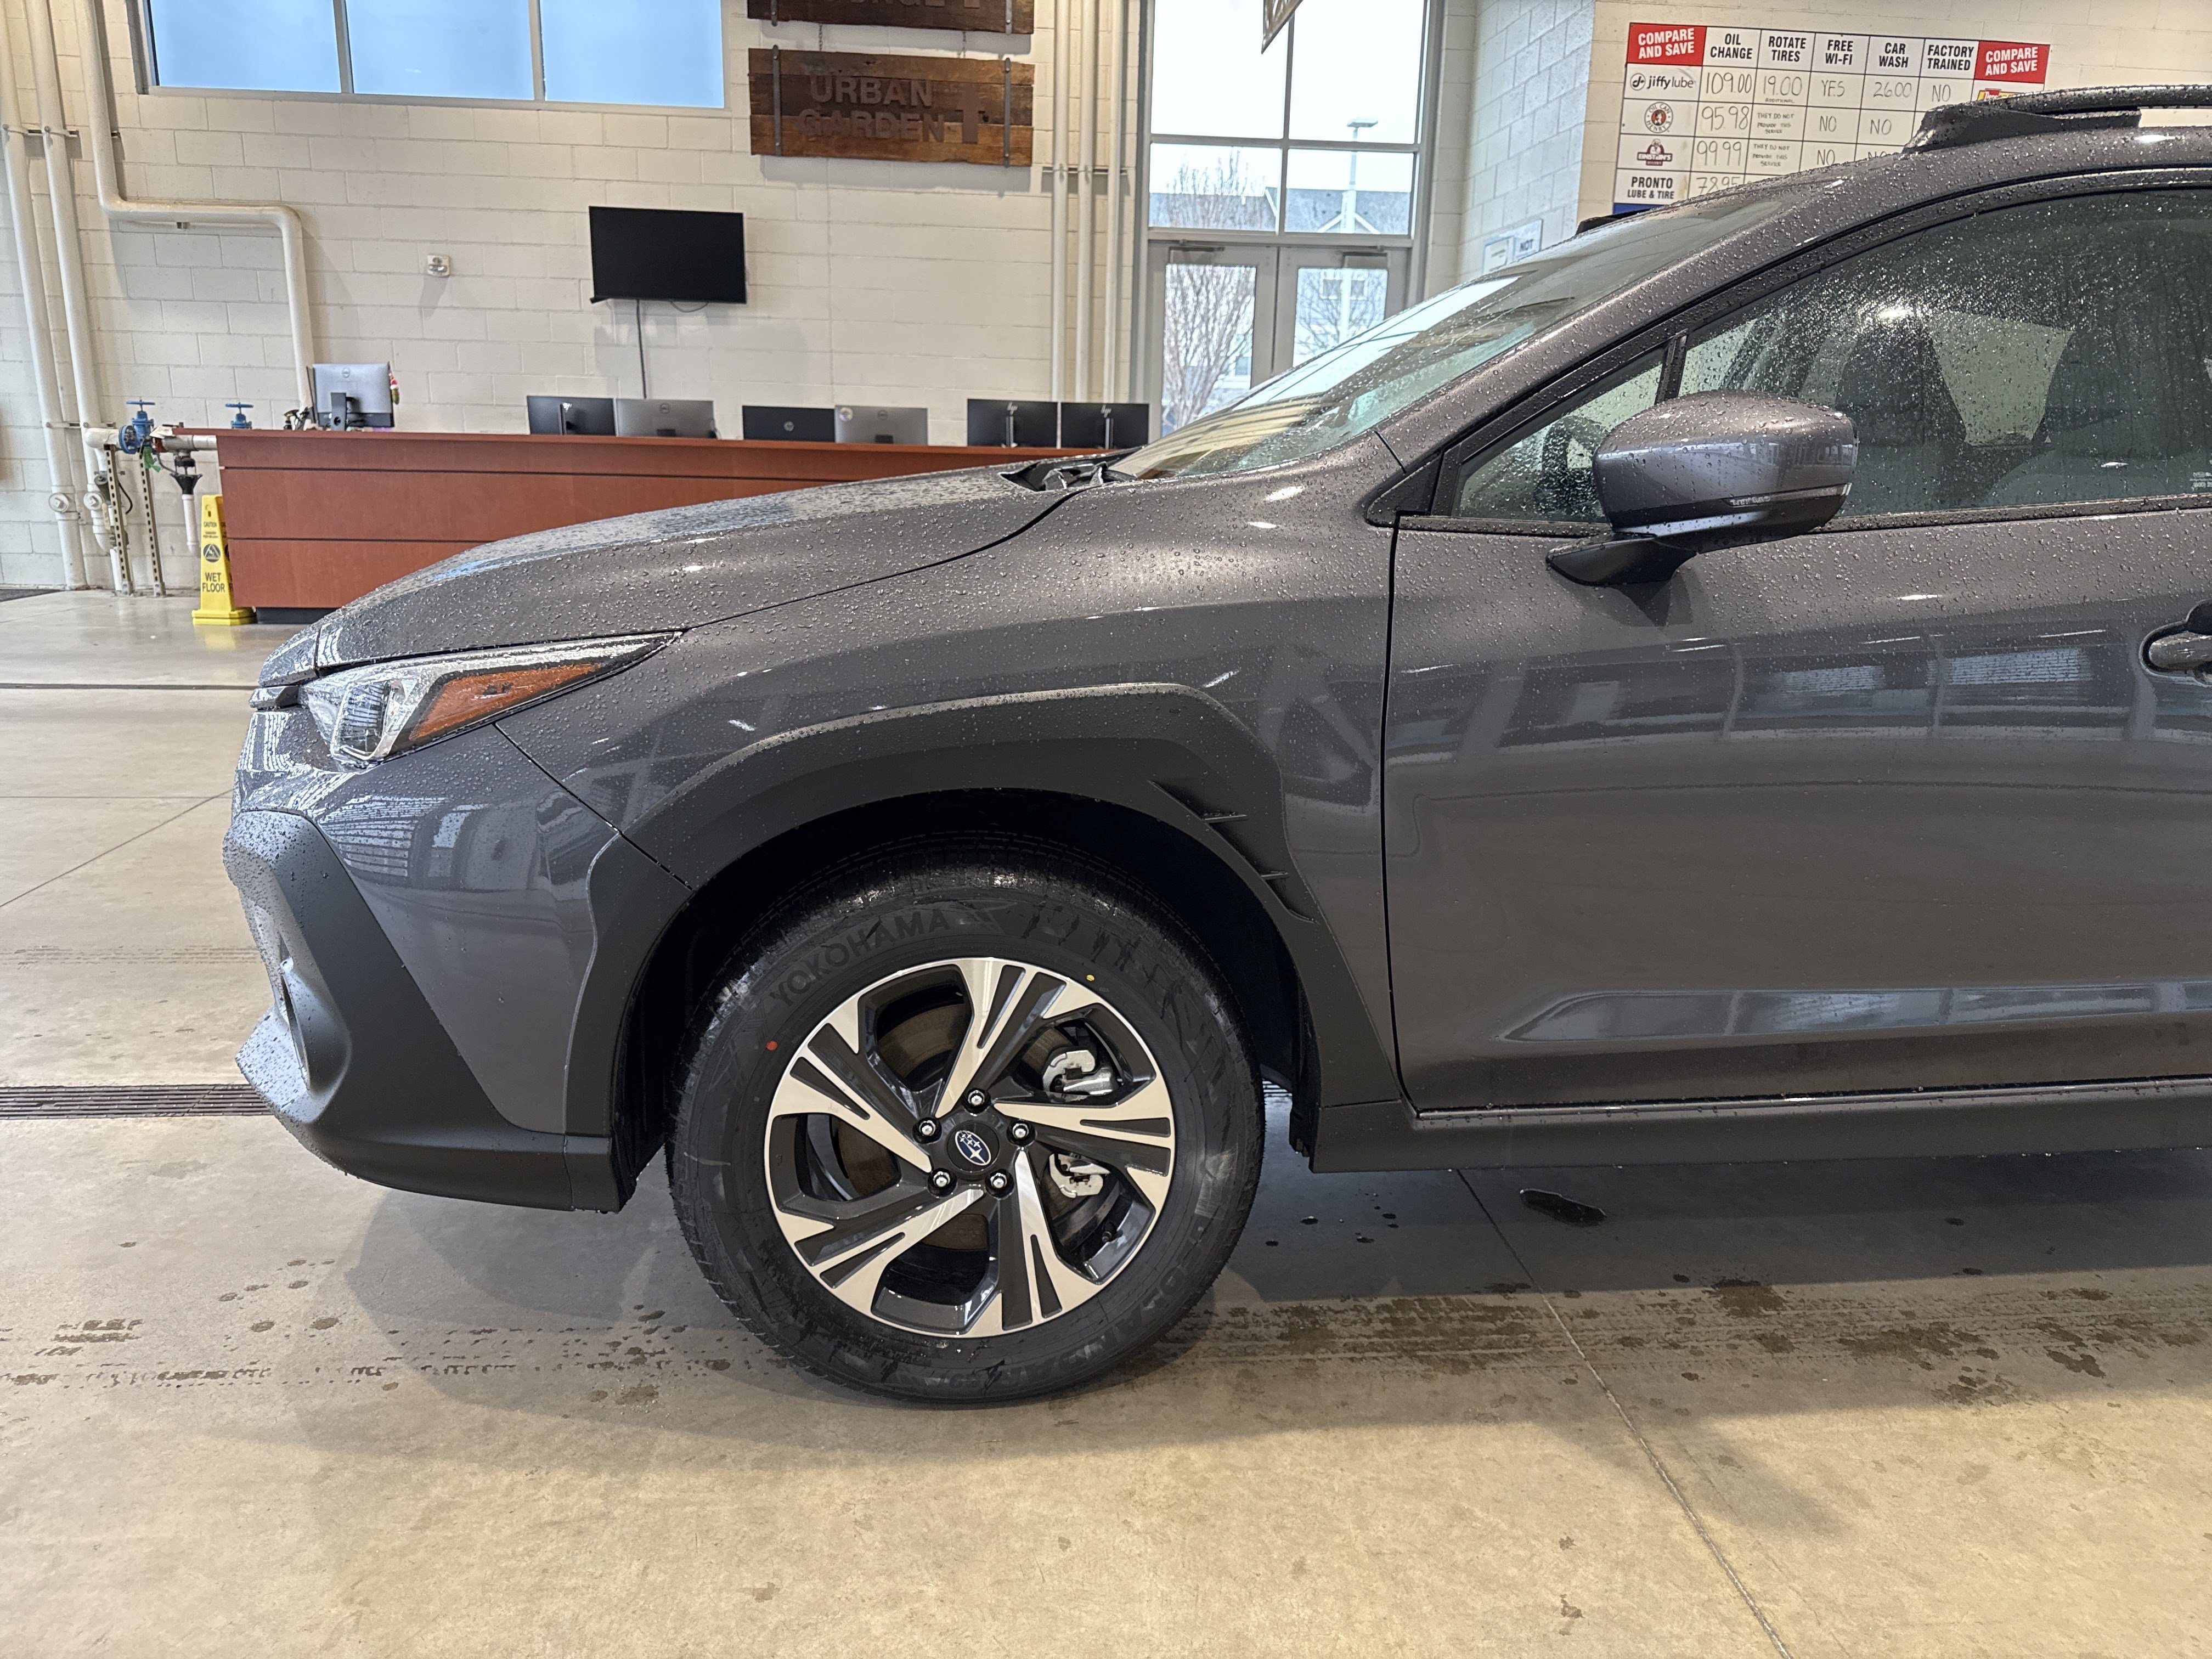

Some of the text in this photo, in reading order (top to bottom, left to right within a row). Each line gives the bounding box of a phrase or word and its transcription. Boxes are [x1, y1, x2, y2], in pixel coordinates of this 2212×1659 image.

[1638, 28, 1695, 46] COMPARE
[1725, 33, 1741, 45] OIL
[1768, 36, 1806, 49] ROTATE
[1638, 41, 1695, 59] AND SAVE
[1710, 46, 1753, 59] CHANGE
[1827, 40, 1853, 52] FREE
[1884, 42, 1906, 54] CAR
[1928, 44, 1974, 58] FACTORY
[1771, 49, 1800, 62] TIRES
[1825, 53, 1853, 65] WI-FI
[1878, 55, 1909, 68] WASH
[1985, 46, 2038, 63] COMPARE
[1927, 58, 1971, 71] TRAINED
[1985, 60, 2038, 76] AND SAVE
[810, 73, 933, 107] URBAN
[1706, 72, 1752, 94] 109.00
[1763, 75, 1802, 95] 19.00
[1821, 80, 1845, 97] YES
[1932, 84, 1951, 103] NO
[1649, 103, 1671, 114] OIL CAN
[797, 109, 944, 143] GARDEN
[1819, 115, 1837, 132] NO
[1870, 119, 1892, 135] NO
[1817, 149, 1836, 165] NO
[1631, 176, 1673, 189] PRONTO
[1627, 189, 1674, 199] LUBE & TIRE
[205, 572, 222, 582] WET
[202, 583, 225, 592] FLOOR
[769, 909, 951, 1007] YOKOHAMA
